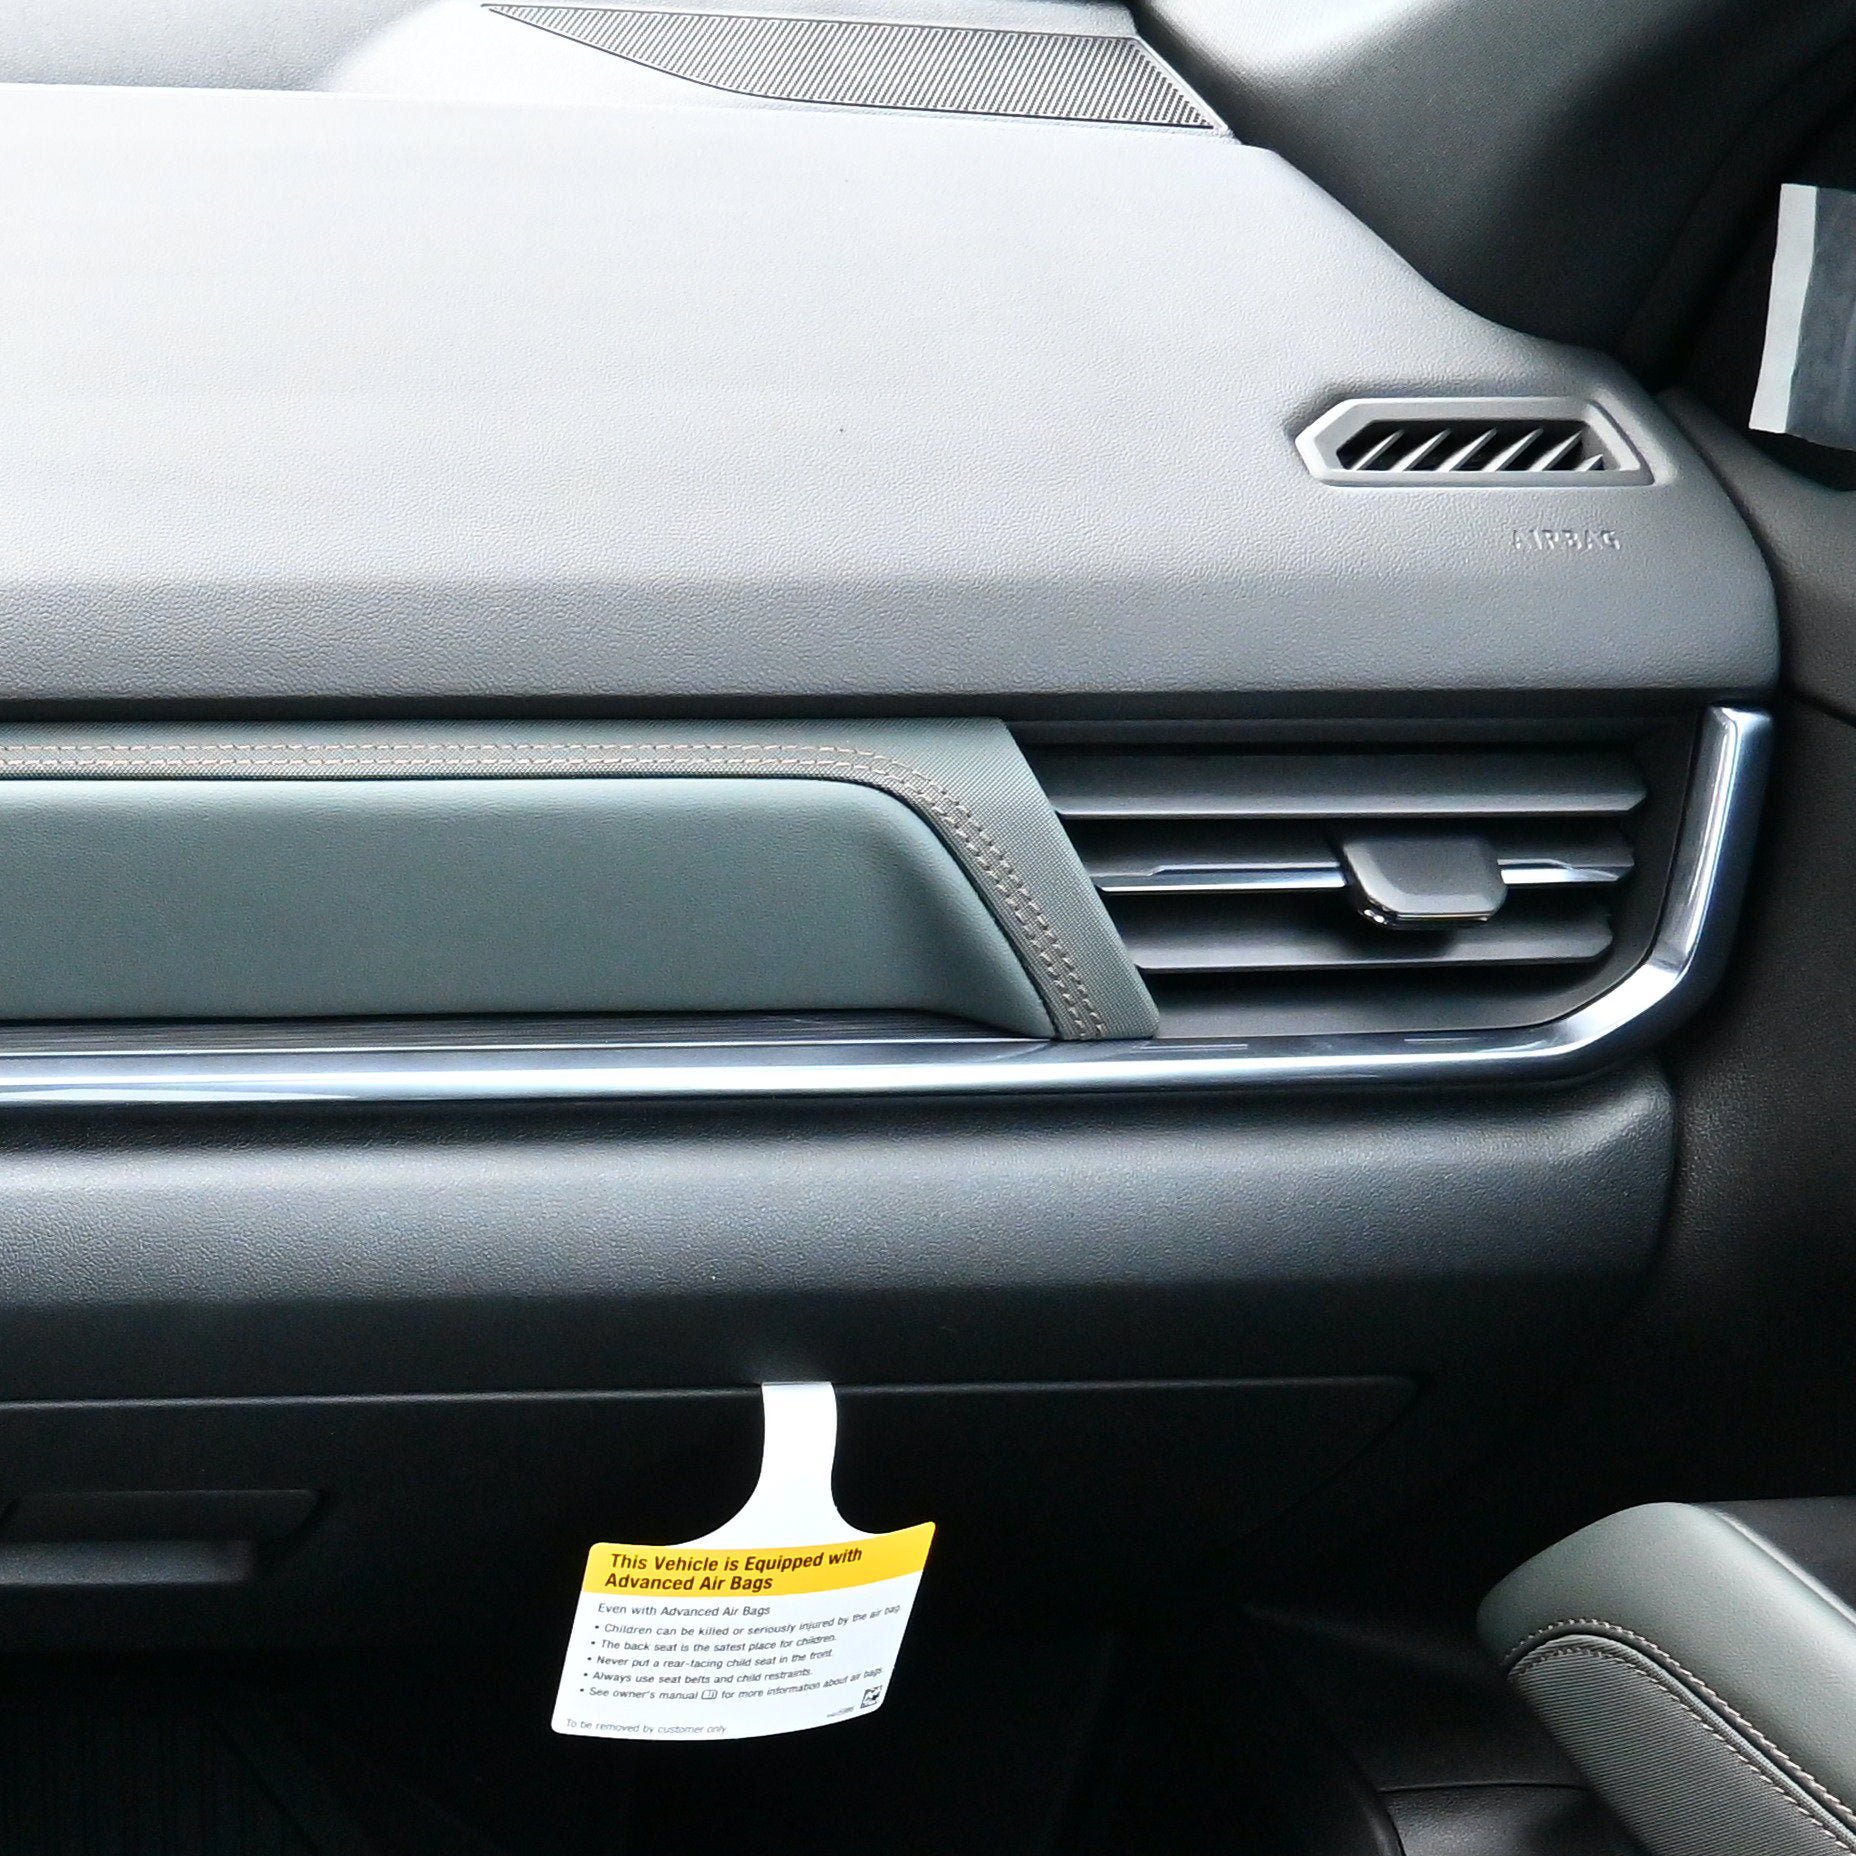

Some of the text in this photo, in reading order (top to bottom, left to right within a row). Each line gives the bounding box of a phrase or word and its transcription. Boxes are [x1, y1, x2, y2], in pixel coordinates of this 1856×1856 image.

[612, 1548, 863, 1573] This Vehicle is Equipped with
[605, 1573, 774, 1593] Advanced Air Bags
[598, 1602, 771, 1617] Even with Advanced Air Bags
[604, 1623, 653, 1635] Children
[655, 1626, 677, 1636] can
[681, 1626, 695, 1636] be
[698, 1626, 730, 1636] killed
[732, 1626, 745, 1636] or
[747, 1623, 796, 1636] seriously
[799, 1618, 835, 1633] injured
[837, 1616, 849, 1627] by
[852, 1612, 868, 1622] the
[601, 1639, 621, 1649] The
[624, 1640, 651, 1651] back
[654, 1642, 678, 1652] seat
[681, 1642, 689, 1652] is
[693, 1642, 711, 1652] the
[713, 1642, 746, 1652] safest
[748, 1641, 777, 1653] place
[779, 1639, 794, 1649] for
[597, 1655, 629, 1666] Never
[632, 1658, 651, 1668] put
[653, 1660, 660, 1668] a
[663, 1659, 723, 1669] rear-facing
[726, 1657, 752, 1668] child
[754, 1656, 777, 1666] seat
[779, 1655, 788, 1664] in
[791, 1652, 807, 1663] the
[592, 1671, 632, 1684] Always
[635, 1674, 655, 1683] use
[658, 1675, 681, 1684] seat
[684, 1674, 711, 1684] belts
[713, 1673, 734, 1684] and
[736, 1672, 761, 1683] child
[589, 1687, 610, 1697] See
[659, 1689, 699, 1700] manual
[721, 1688, 735, 1699] for
[738, 1689, 764, 1699] more
[766, 1681, 821, 1696] information
[822, 1674, 849, 1688] about
[566, 1718, 577, 1728] To
